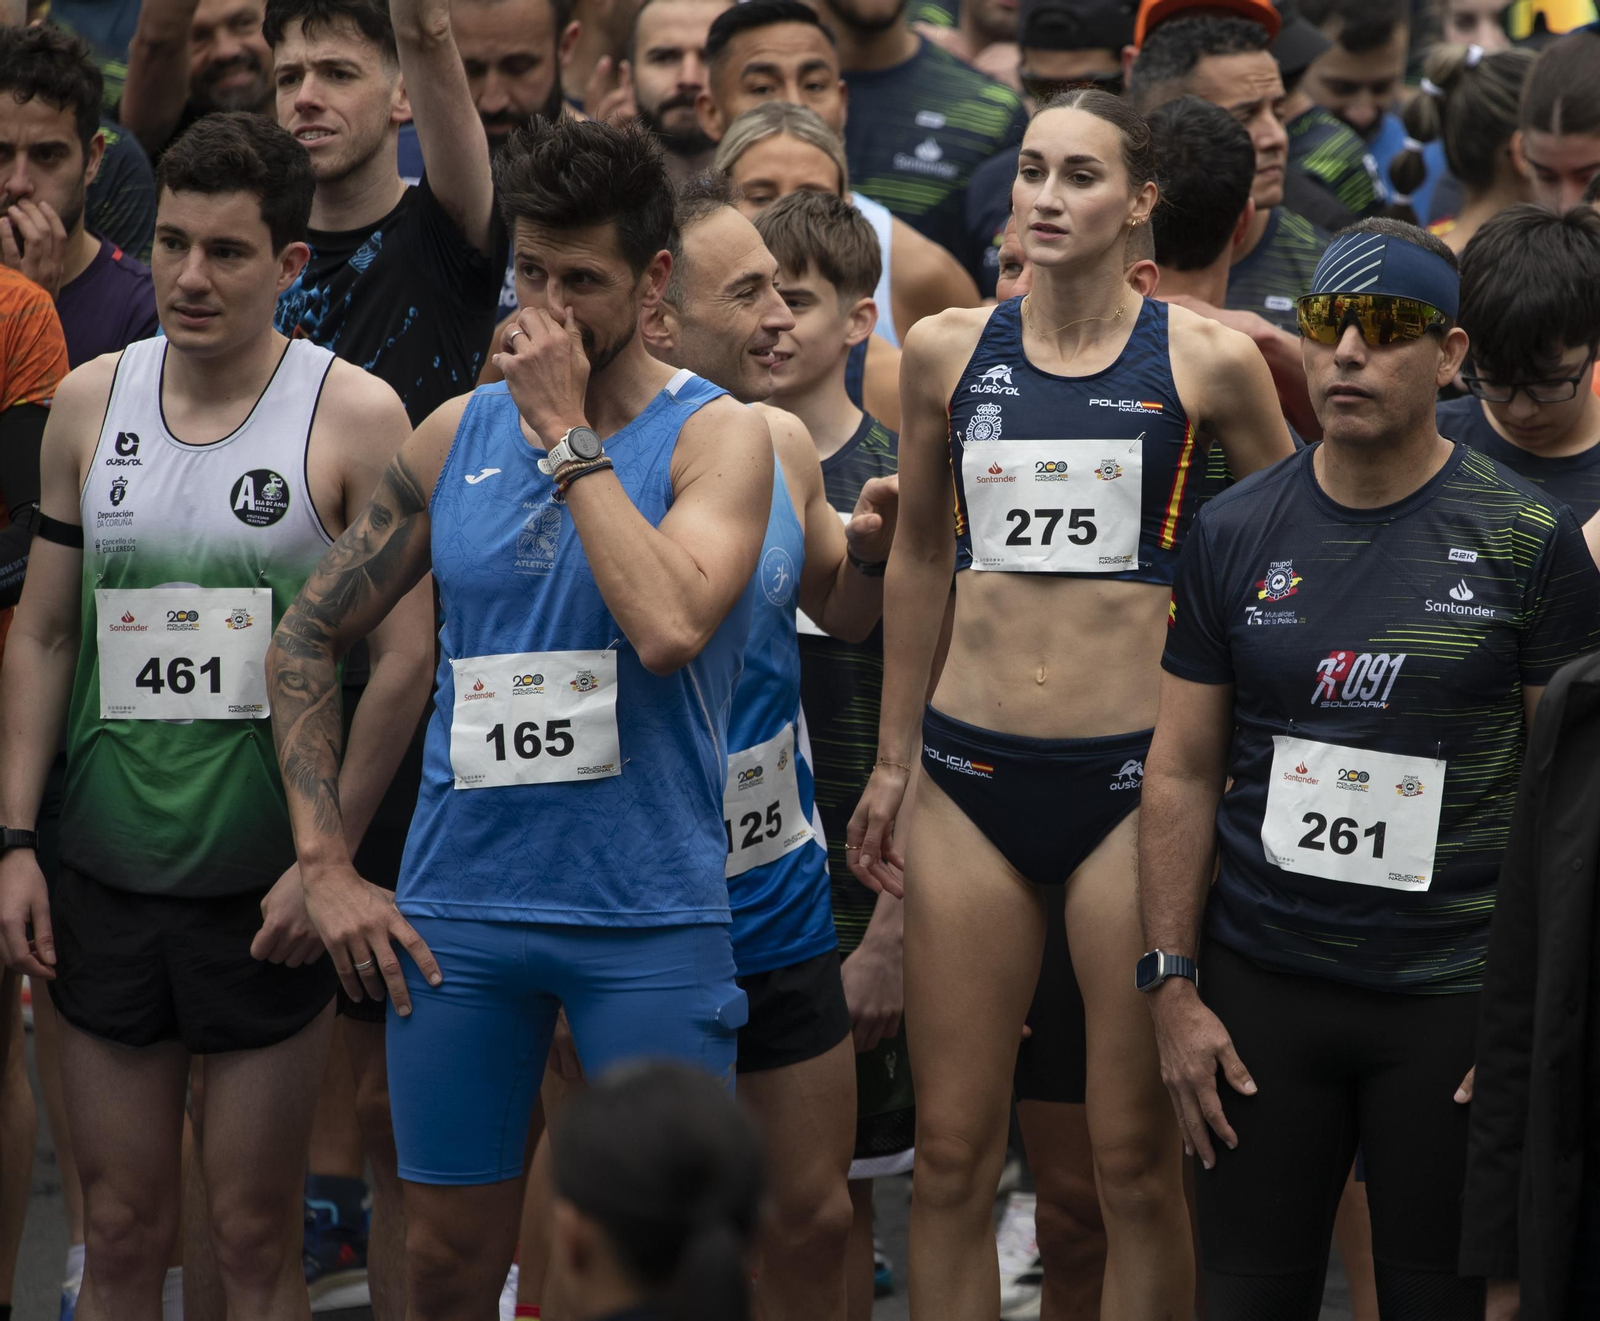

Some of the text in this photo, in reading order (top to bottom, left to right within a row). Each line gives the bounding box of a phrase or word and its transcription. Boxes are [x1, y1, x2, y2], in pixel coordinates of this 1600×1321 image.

[970, 385, 1020, 397] austral
[976, 475, 1016, 484] Santander
[98, 511, 133, 520] Deputación
[106, 518, 133, 527] CORUÑA
[1005, 508, 1097, 546] 275
[102, 538, 126, 546] Concello
[103, 545, 136, 554] CULLEREDO
[1451, 550, 1476, 561] 42K
[1270, 559, 1292, 569] mupol
[1264, 610, 1296, 618] Mutualidad
[1425, 600, 1496, 618] Santander
[1245, 606, 1263, 625] 75
[109, 624, 148, 632] Santander
[135, 656, 221, 694] 461
[464, 692, 496, 701] Santander
[1320, 701, 1386, 709] SOLIDARIA
[486, 719, 575, 761] 165
[947, 763, 992, 779] NACIONAL
[1283, 773, 1319, 786] Santander
[1297, 811, 1387, 859] 261
[1388, 876, 1424, 884] NACIONAL
